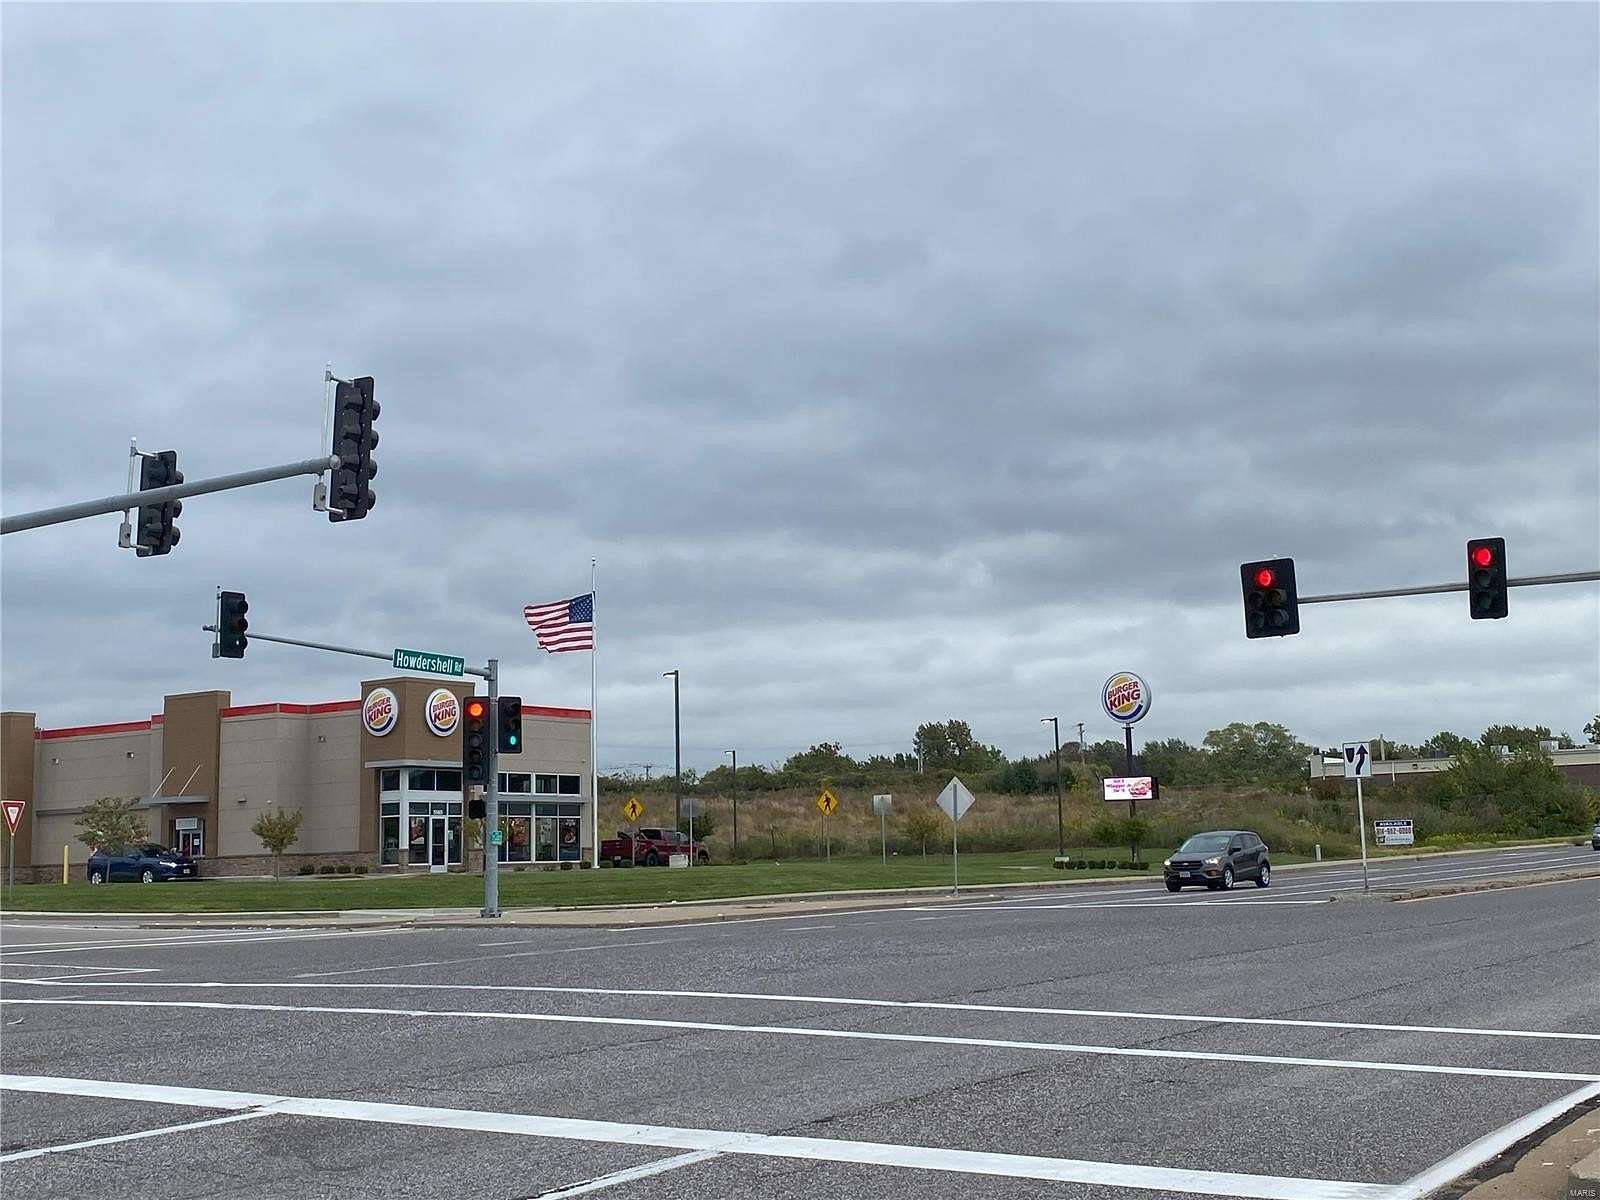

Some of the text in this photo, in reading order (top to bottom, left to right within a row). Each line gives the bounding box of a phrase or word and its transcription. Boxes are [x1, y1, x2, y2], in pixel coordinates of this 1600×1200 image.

[396, 651, 462, 673] Howdershell Rd
[1107, 681, 1139, 700] BURGER
[1109, 689, 1141, 711] KING
[367, 696, 391, 713] BURGER
[368, 704, 392, 724] KING
[432, 699, 456, 713] BURGER
[433, 706, 457, 724] KING
